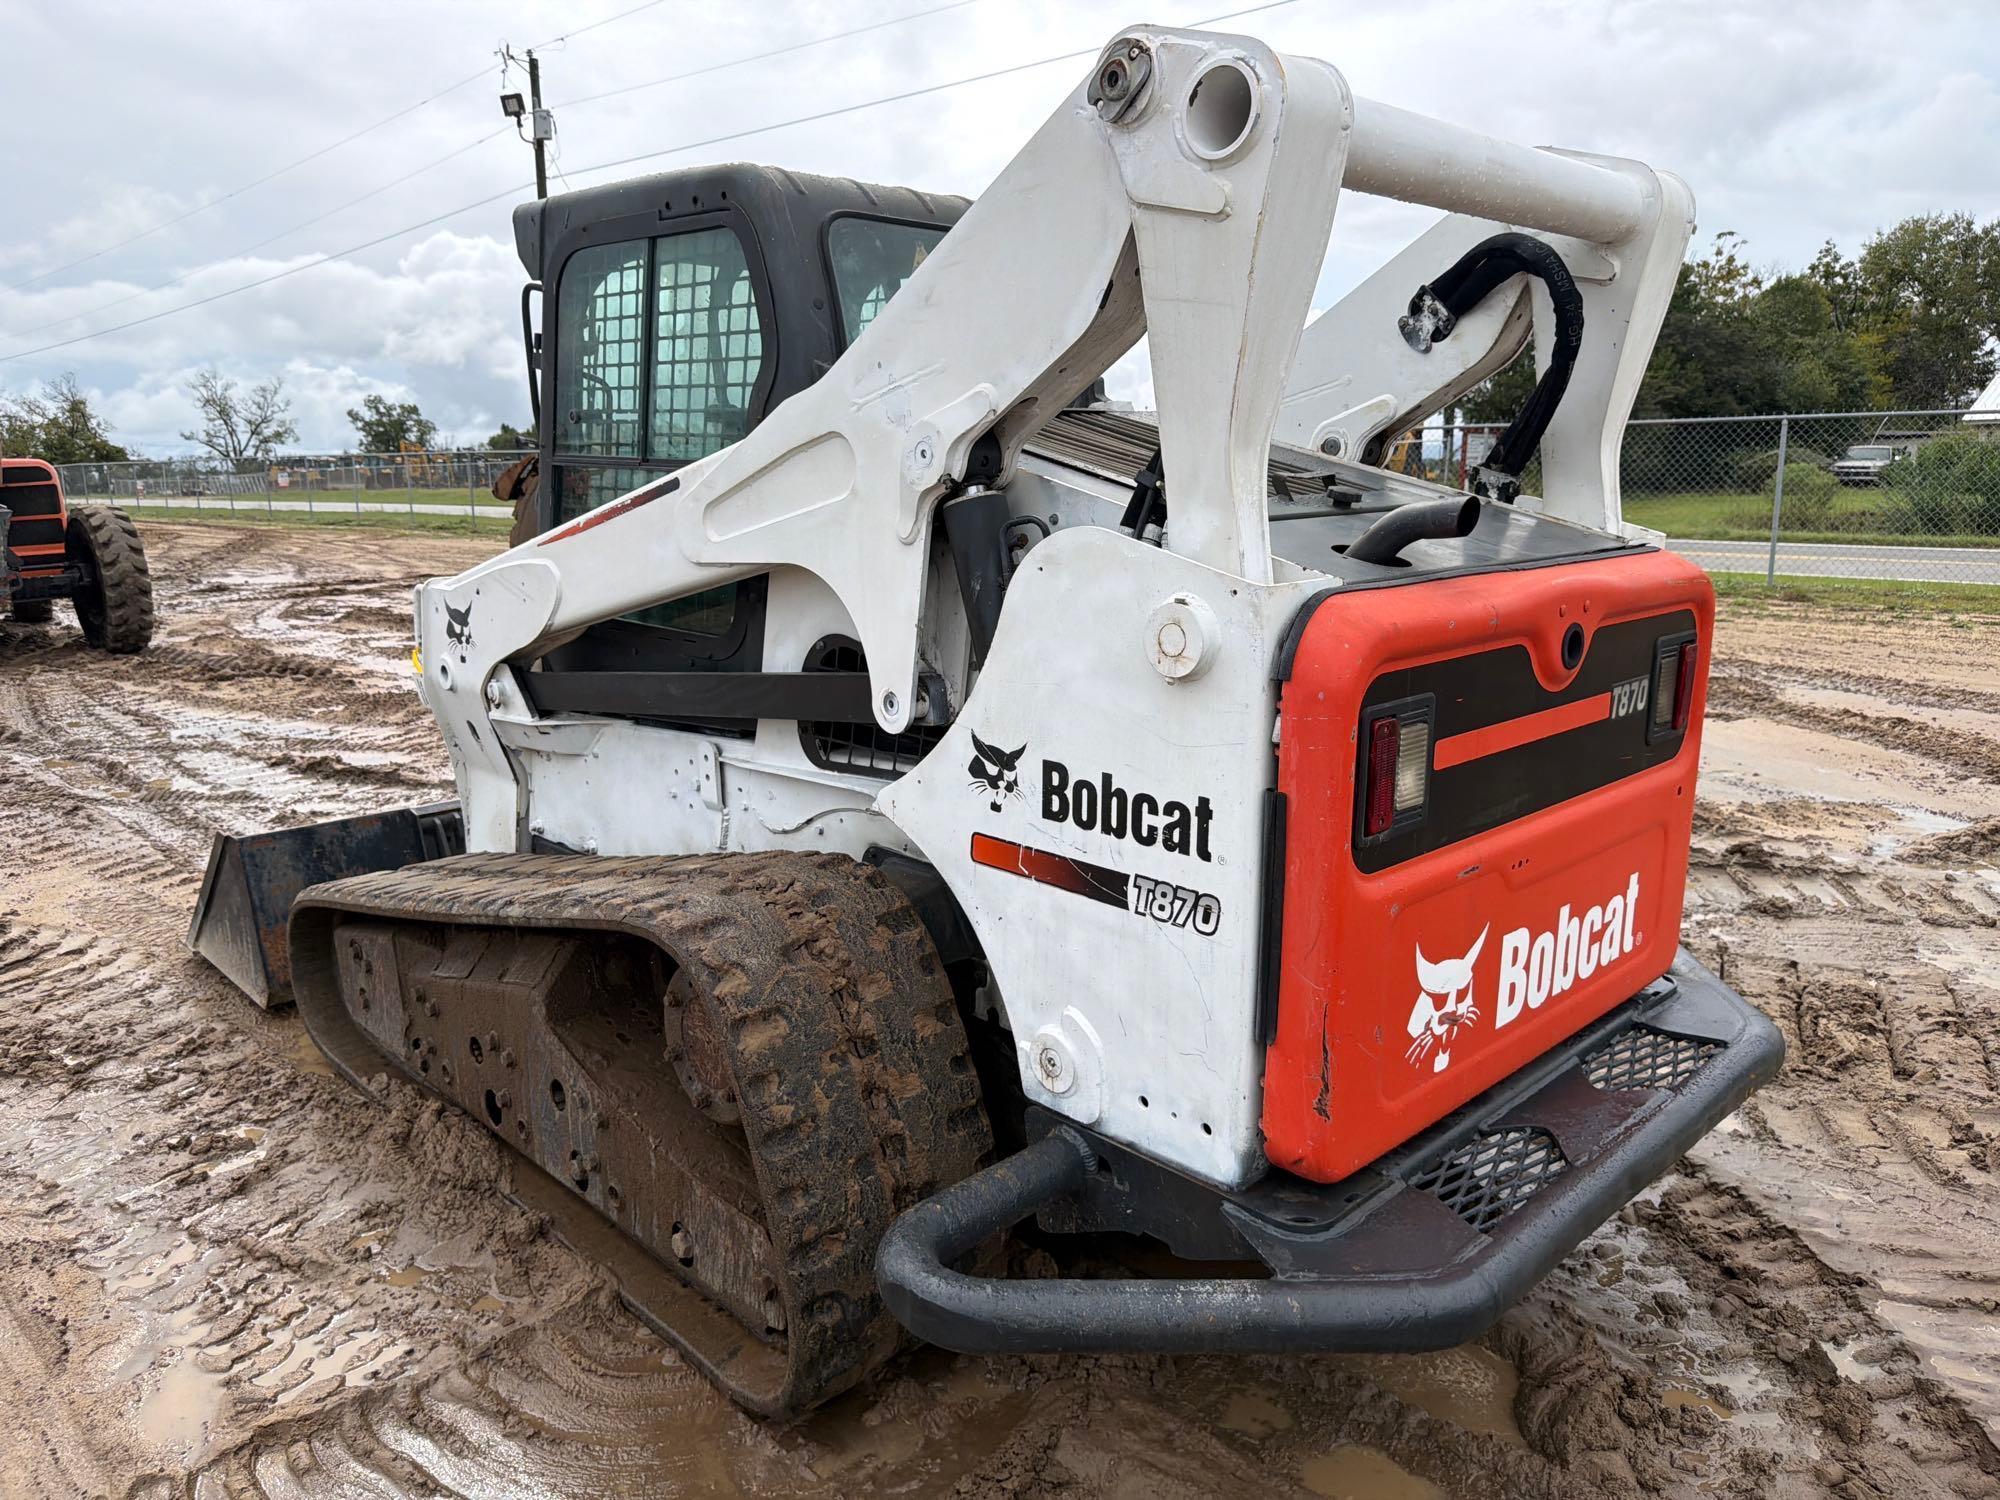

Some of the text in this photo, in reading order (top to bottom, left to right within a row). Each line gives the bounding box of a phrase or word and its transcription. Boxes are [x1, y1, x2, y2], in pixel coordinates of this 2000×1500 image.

[1611, 678, 1649, 719] T870
[1041, 758, 1214, 863] Bobcat
[1133, 873, 1222, 937] T870
[1495, 872, 1640, 1030] Bobcat
